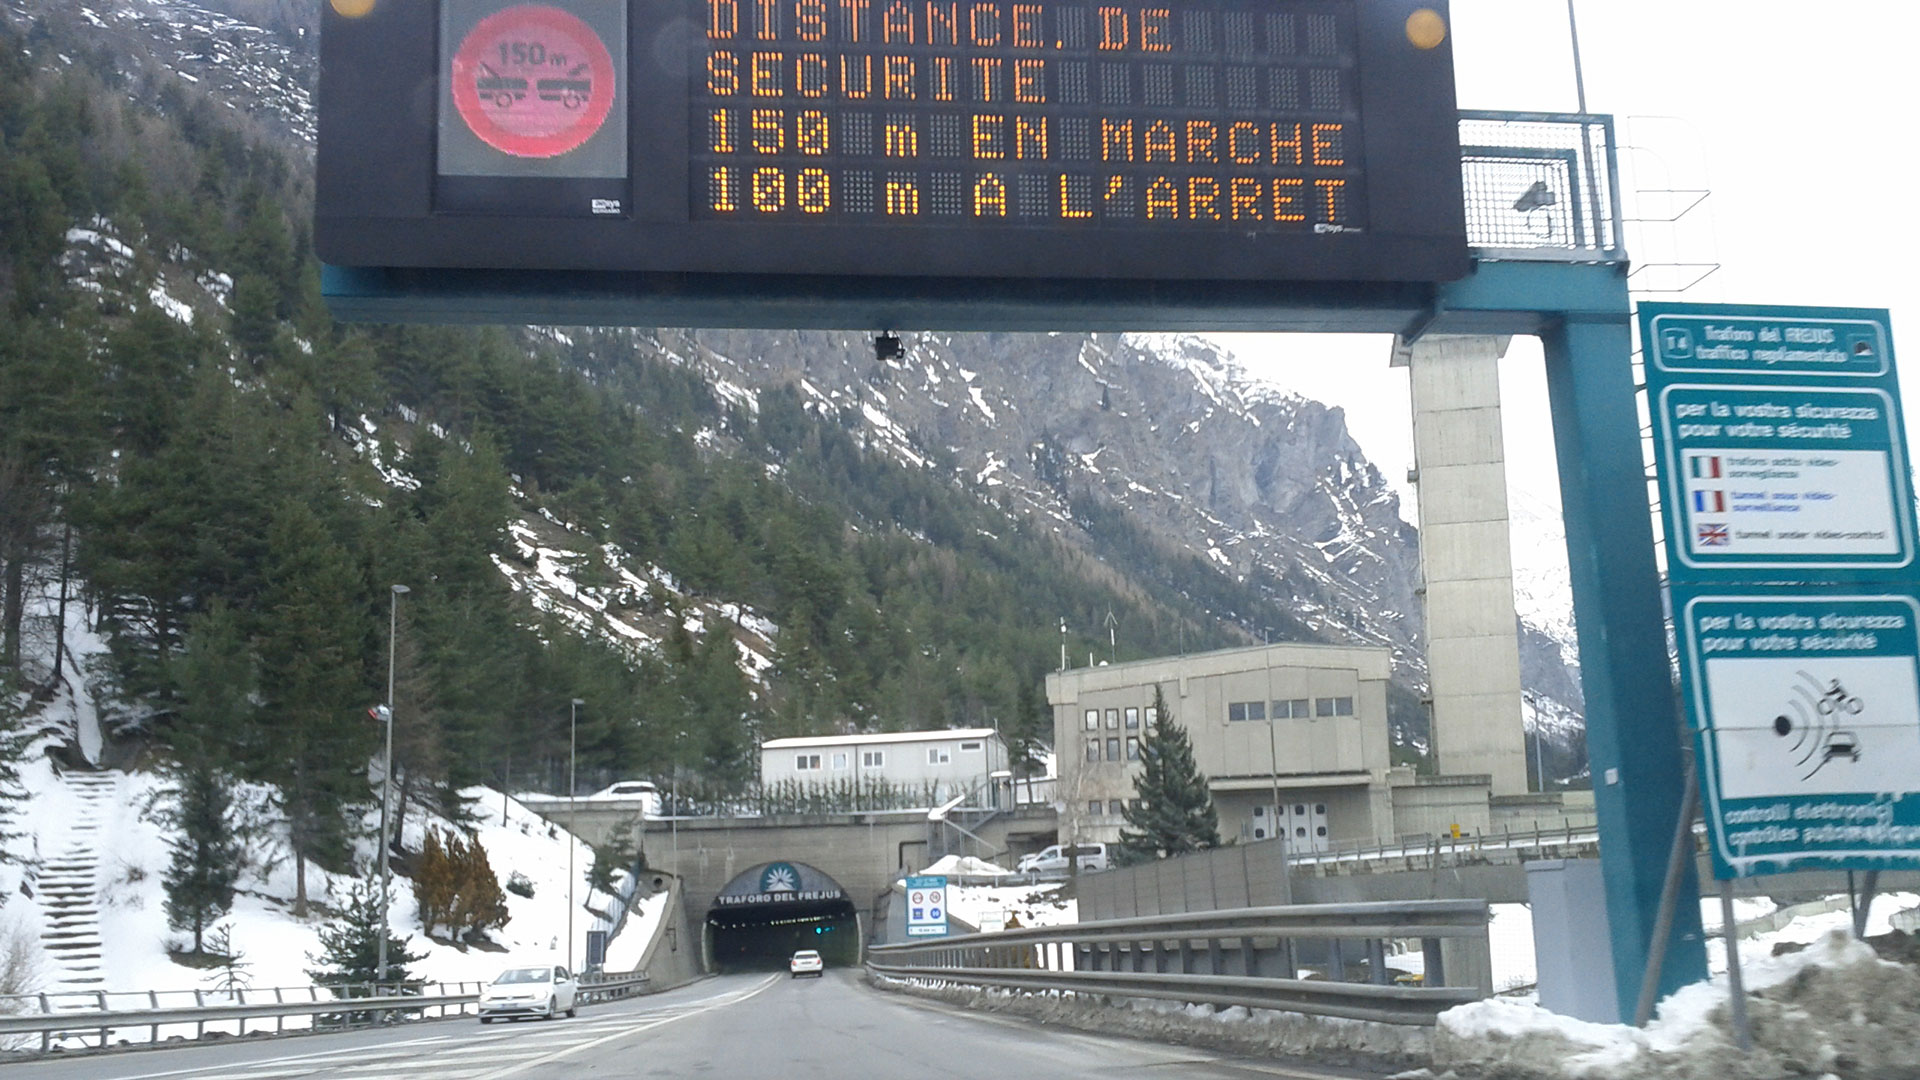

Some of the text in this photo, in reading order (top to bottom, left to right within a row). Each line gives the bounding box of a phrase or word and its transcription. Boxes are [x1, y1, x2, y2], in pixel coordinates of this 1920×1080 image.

[1099, 6, 1172, 51] DE
[497, 42, 567, 66] 150 m
[707, 51, 1046, 102] SECURITE
[712, 108, 1345, 166] 150 m EN MARCHE
[713, 166, 830, 214] 100
[886, 182, 920, 216] m
[973, 172, 1007, 217] A
[1758, 326, 1782, 343] del
[1784, 327, 1836, 344] FREJUS
[1675, 401, 1879, 420] per la vostra sicurezza
[1678, 422, 1852, 440] pour votre sécurité
[1700, 612, 1906, 634] per la vostra sicurezza
[1701, 632, 1878, 655] pour votre sécurité
[719, 890, 841, 905] TRAFORO DEL FREJUS
